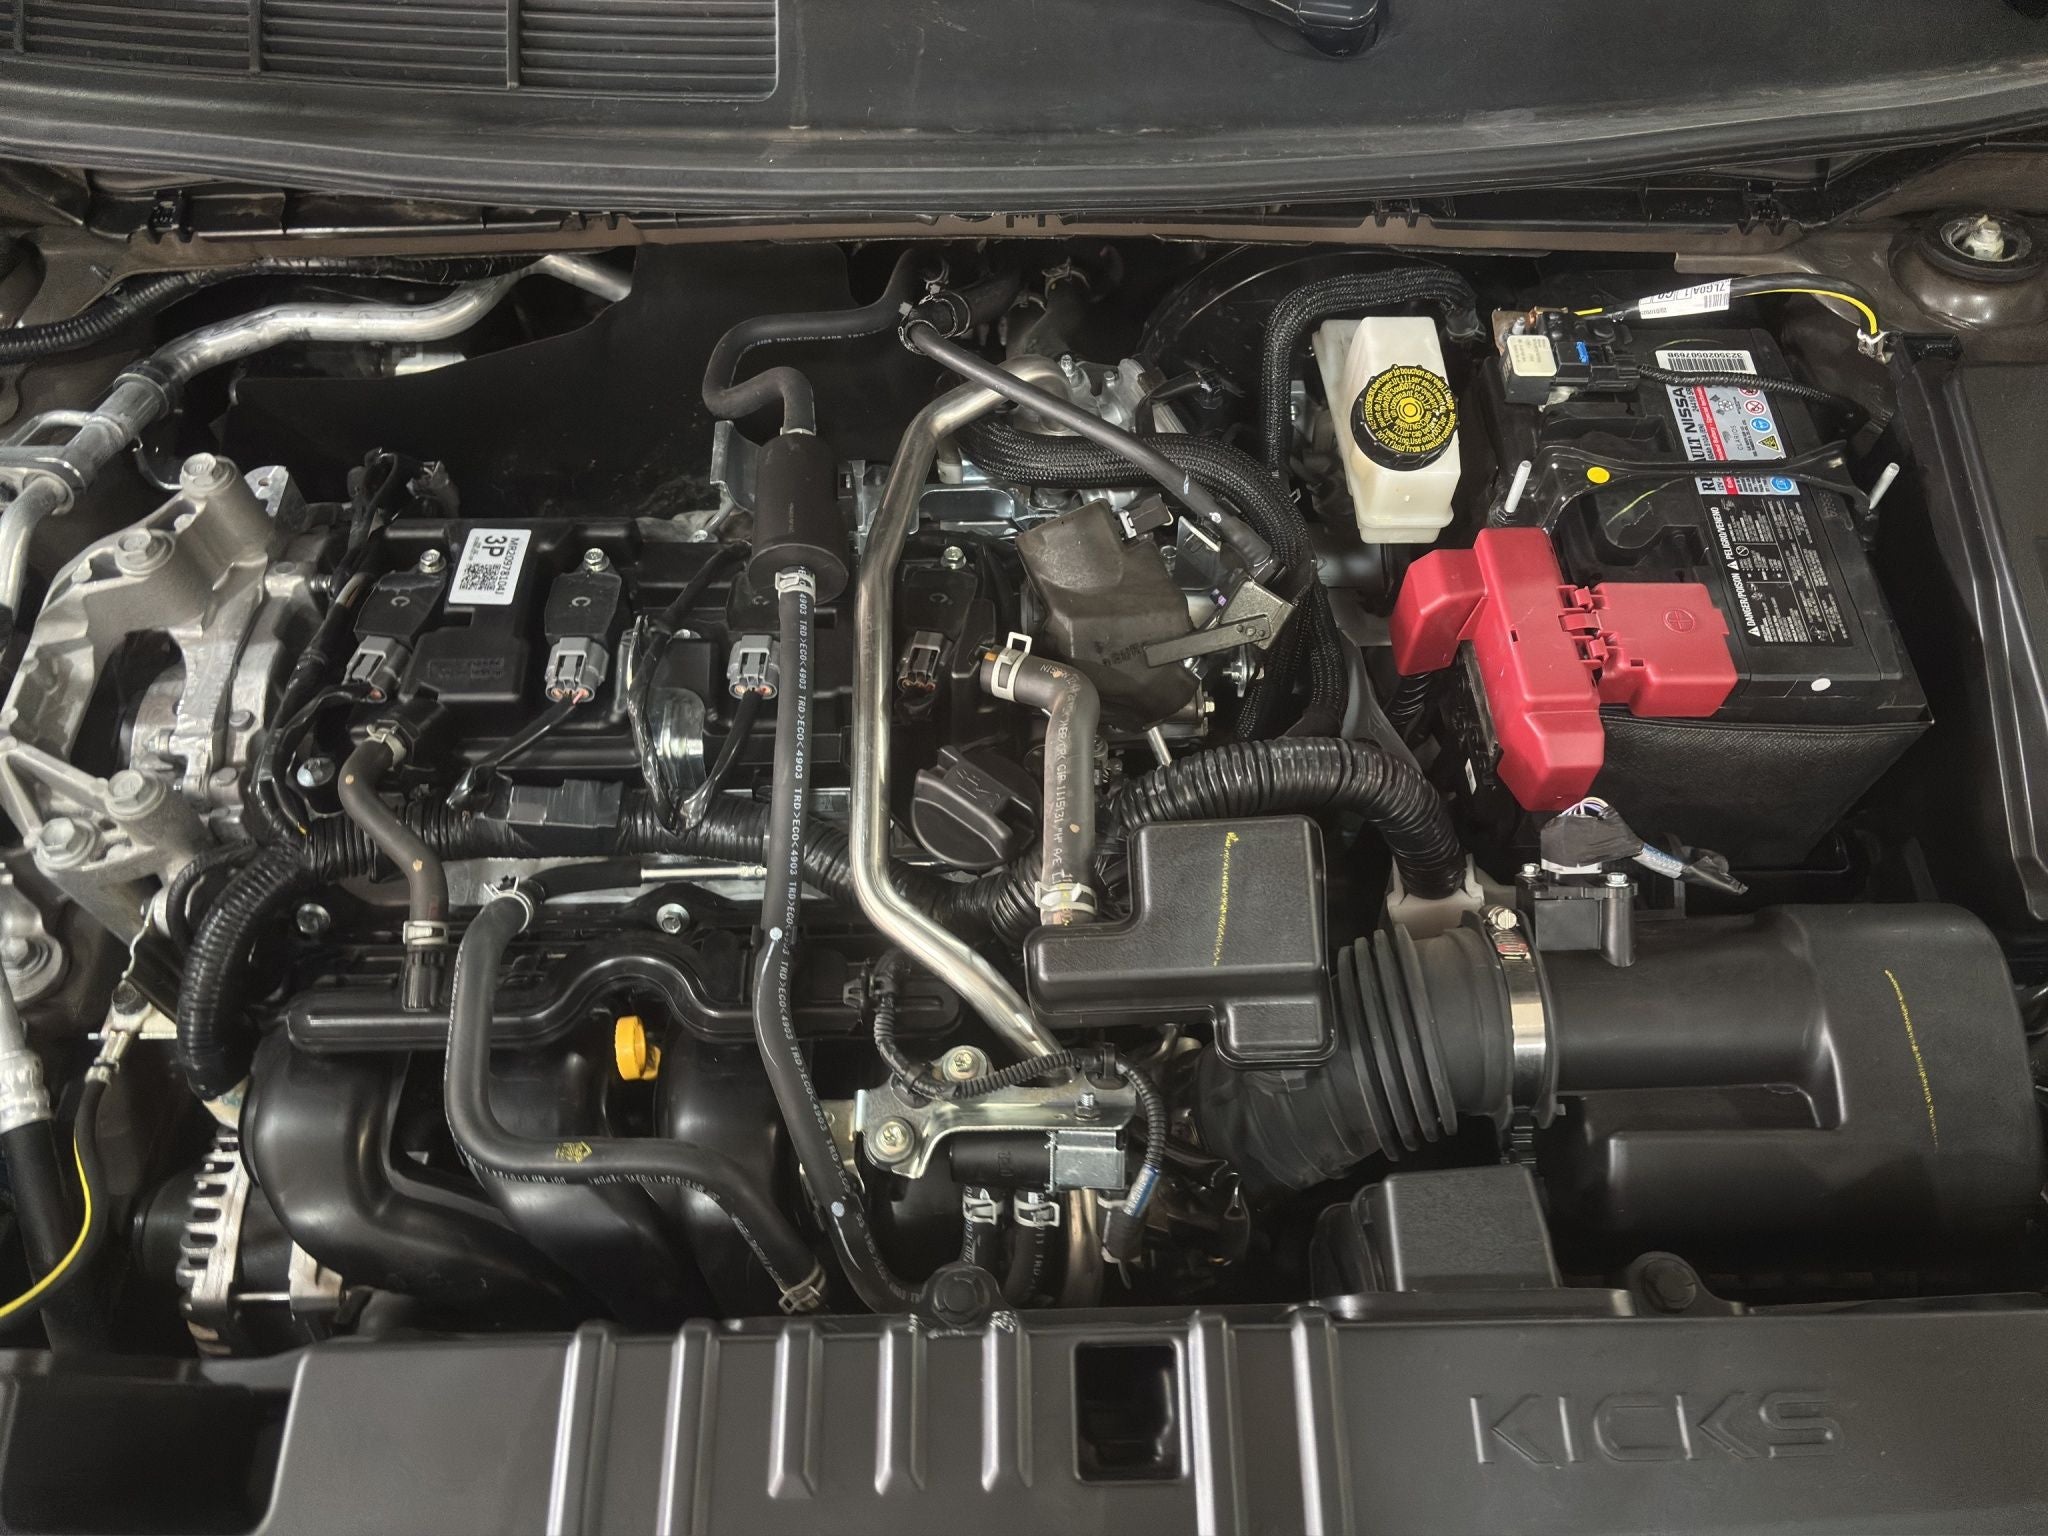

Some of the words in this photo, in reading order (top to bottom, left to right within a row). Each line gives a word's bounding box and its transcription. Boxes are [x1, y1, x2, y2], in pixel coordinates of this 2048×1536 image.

[1670, 386, 1698, 433] NISSA
[482, 535, 508, 557] 3P
[1470, 1391, 1843, 1467] KICKS
